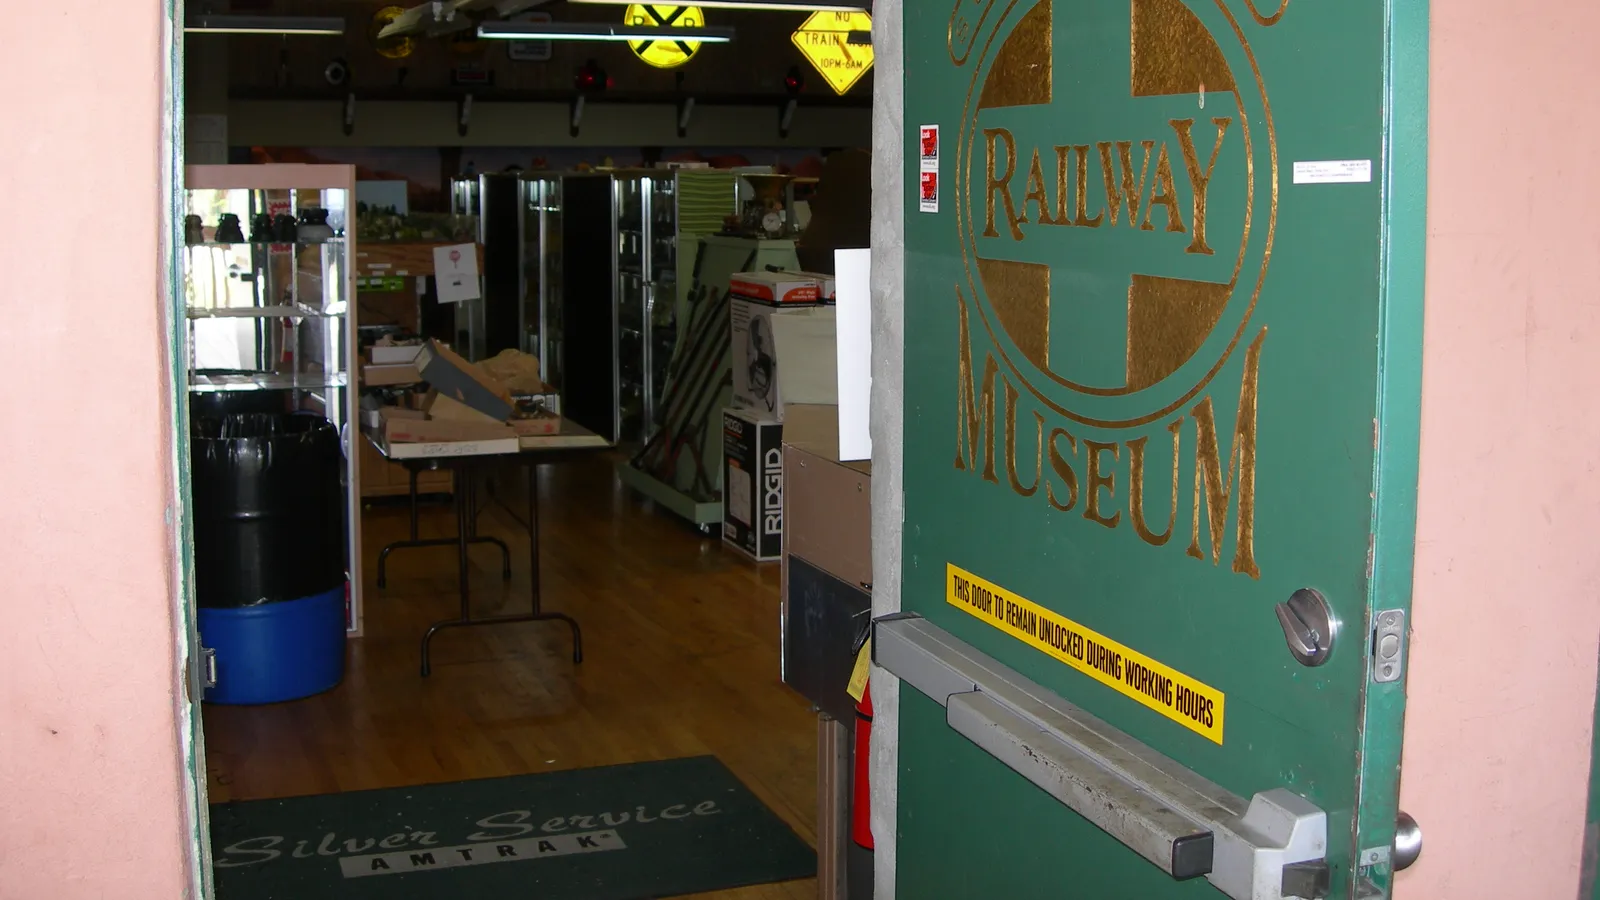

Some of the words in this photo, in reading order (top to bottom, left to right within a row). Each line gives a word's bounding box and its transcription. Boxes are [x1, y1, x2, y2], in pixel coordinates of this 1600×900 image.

[805, 32, 840, 46] TRAIN
[835, 11, 850, 22] NO
[983, 116, 1232, 255] RAILWAY
[954, 283, 1268, 581] MUSEUM
[764, 447, 782, 535] RIDGID
[953, 574, 970, 603] THIS
[971, 583, 992, 615] DOOR
[994, 594, 1004, 621] TO
[1006, 600, 1037, 638] REMAIN
[1039, 616, 1084, 661] UNLOCKED
[1086, 636, 1122, 681] DURING
[1124, 657, 1173, 707] WORKING
[1175, 683, 1214, 729] HOURS
[215, 828, 439, 868] Silver
[462, 800, 723, 843] Service
